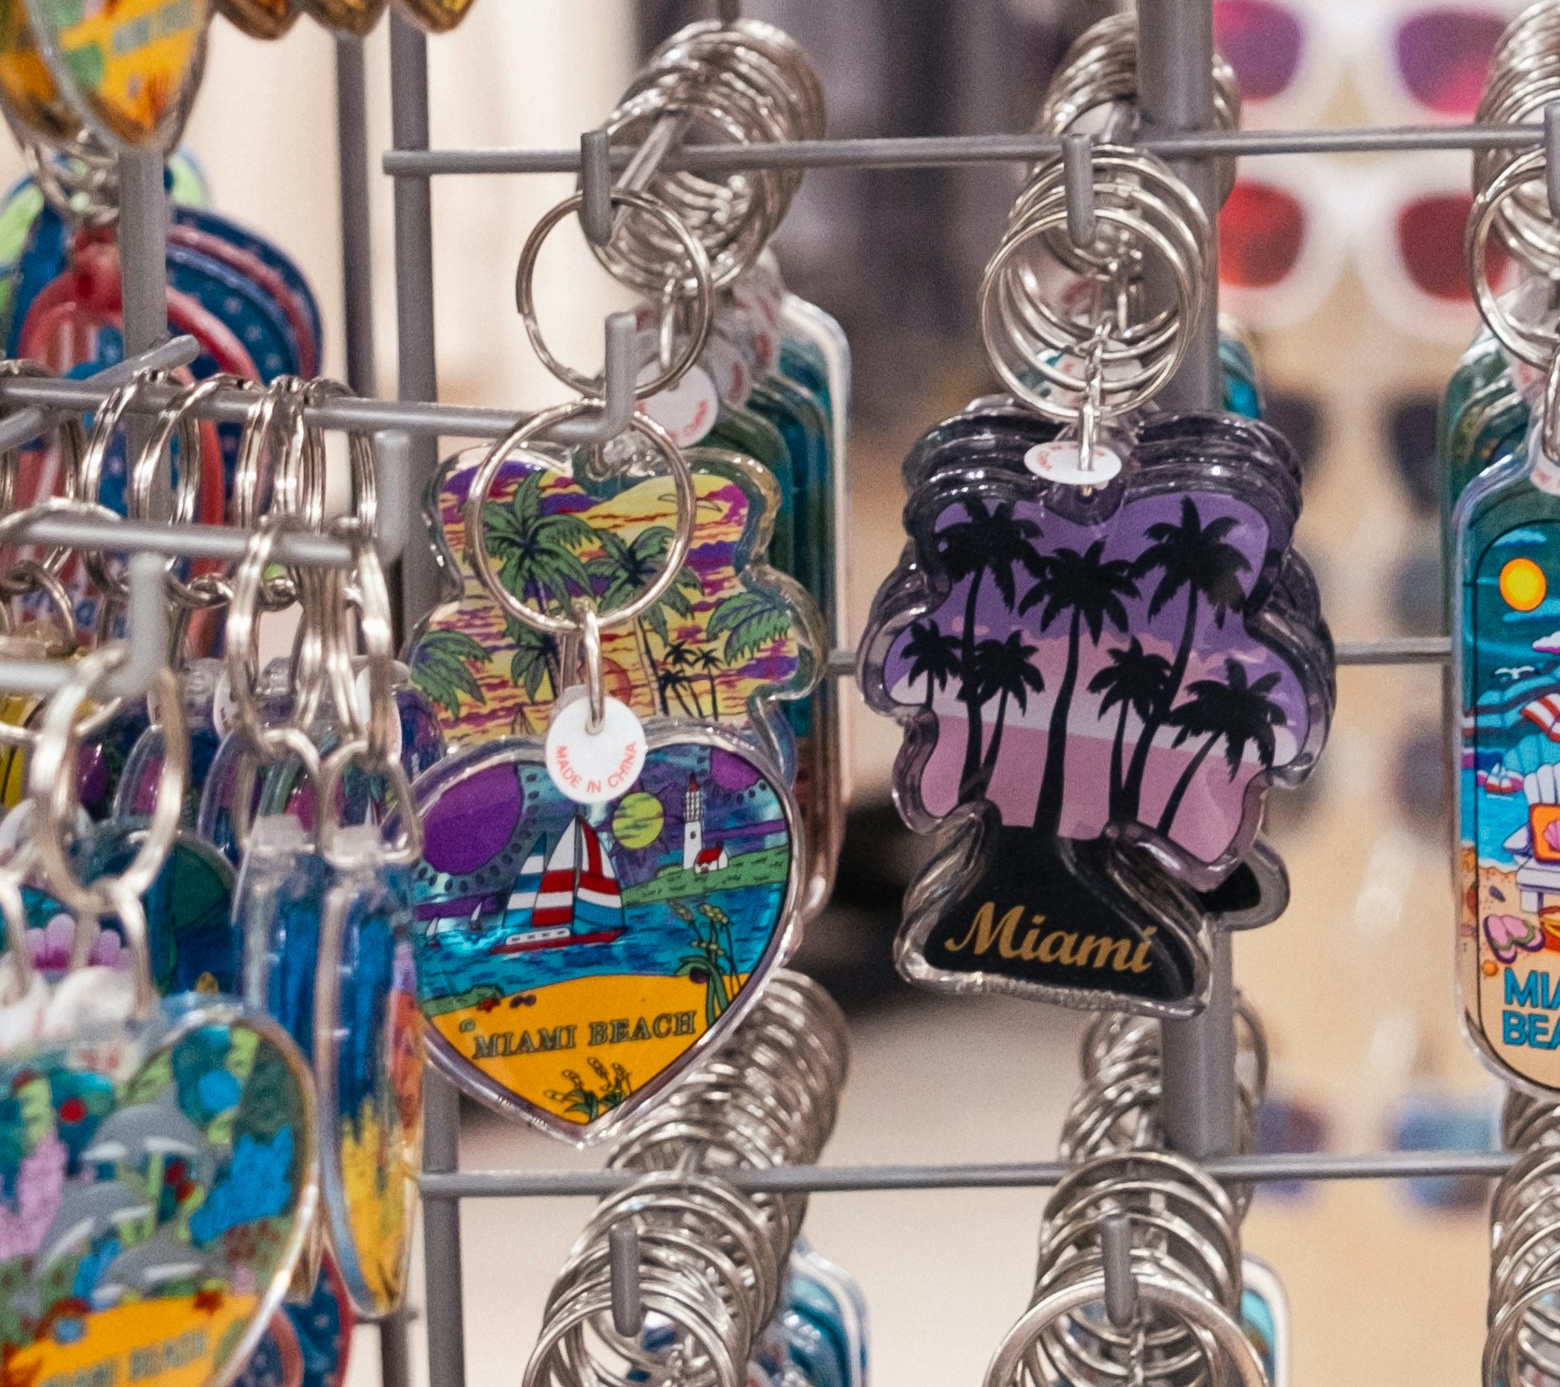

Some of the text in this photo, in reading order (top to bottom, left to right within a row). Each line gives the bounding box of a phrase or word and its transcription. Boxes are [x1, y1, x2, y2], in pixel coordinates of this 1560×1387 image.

[556, 742, 637, 793] MADE IN CHINA
[945, 902, 1157, 973] Miami
[472, 1012, 696, 1059] MIAMI BEACH
